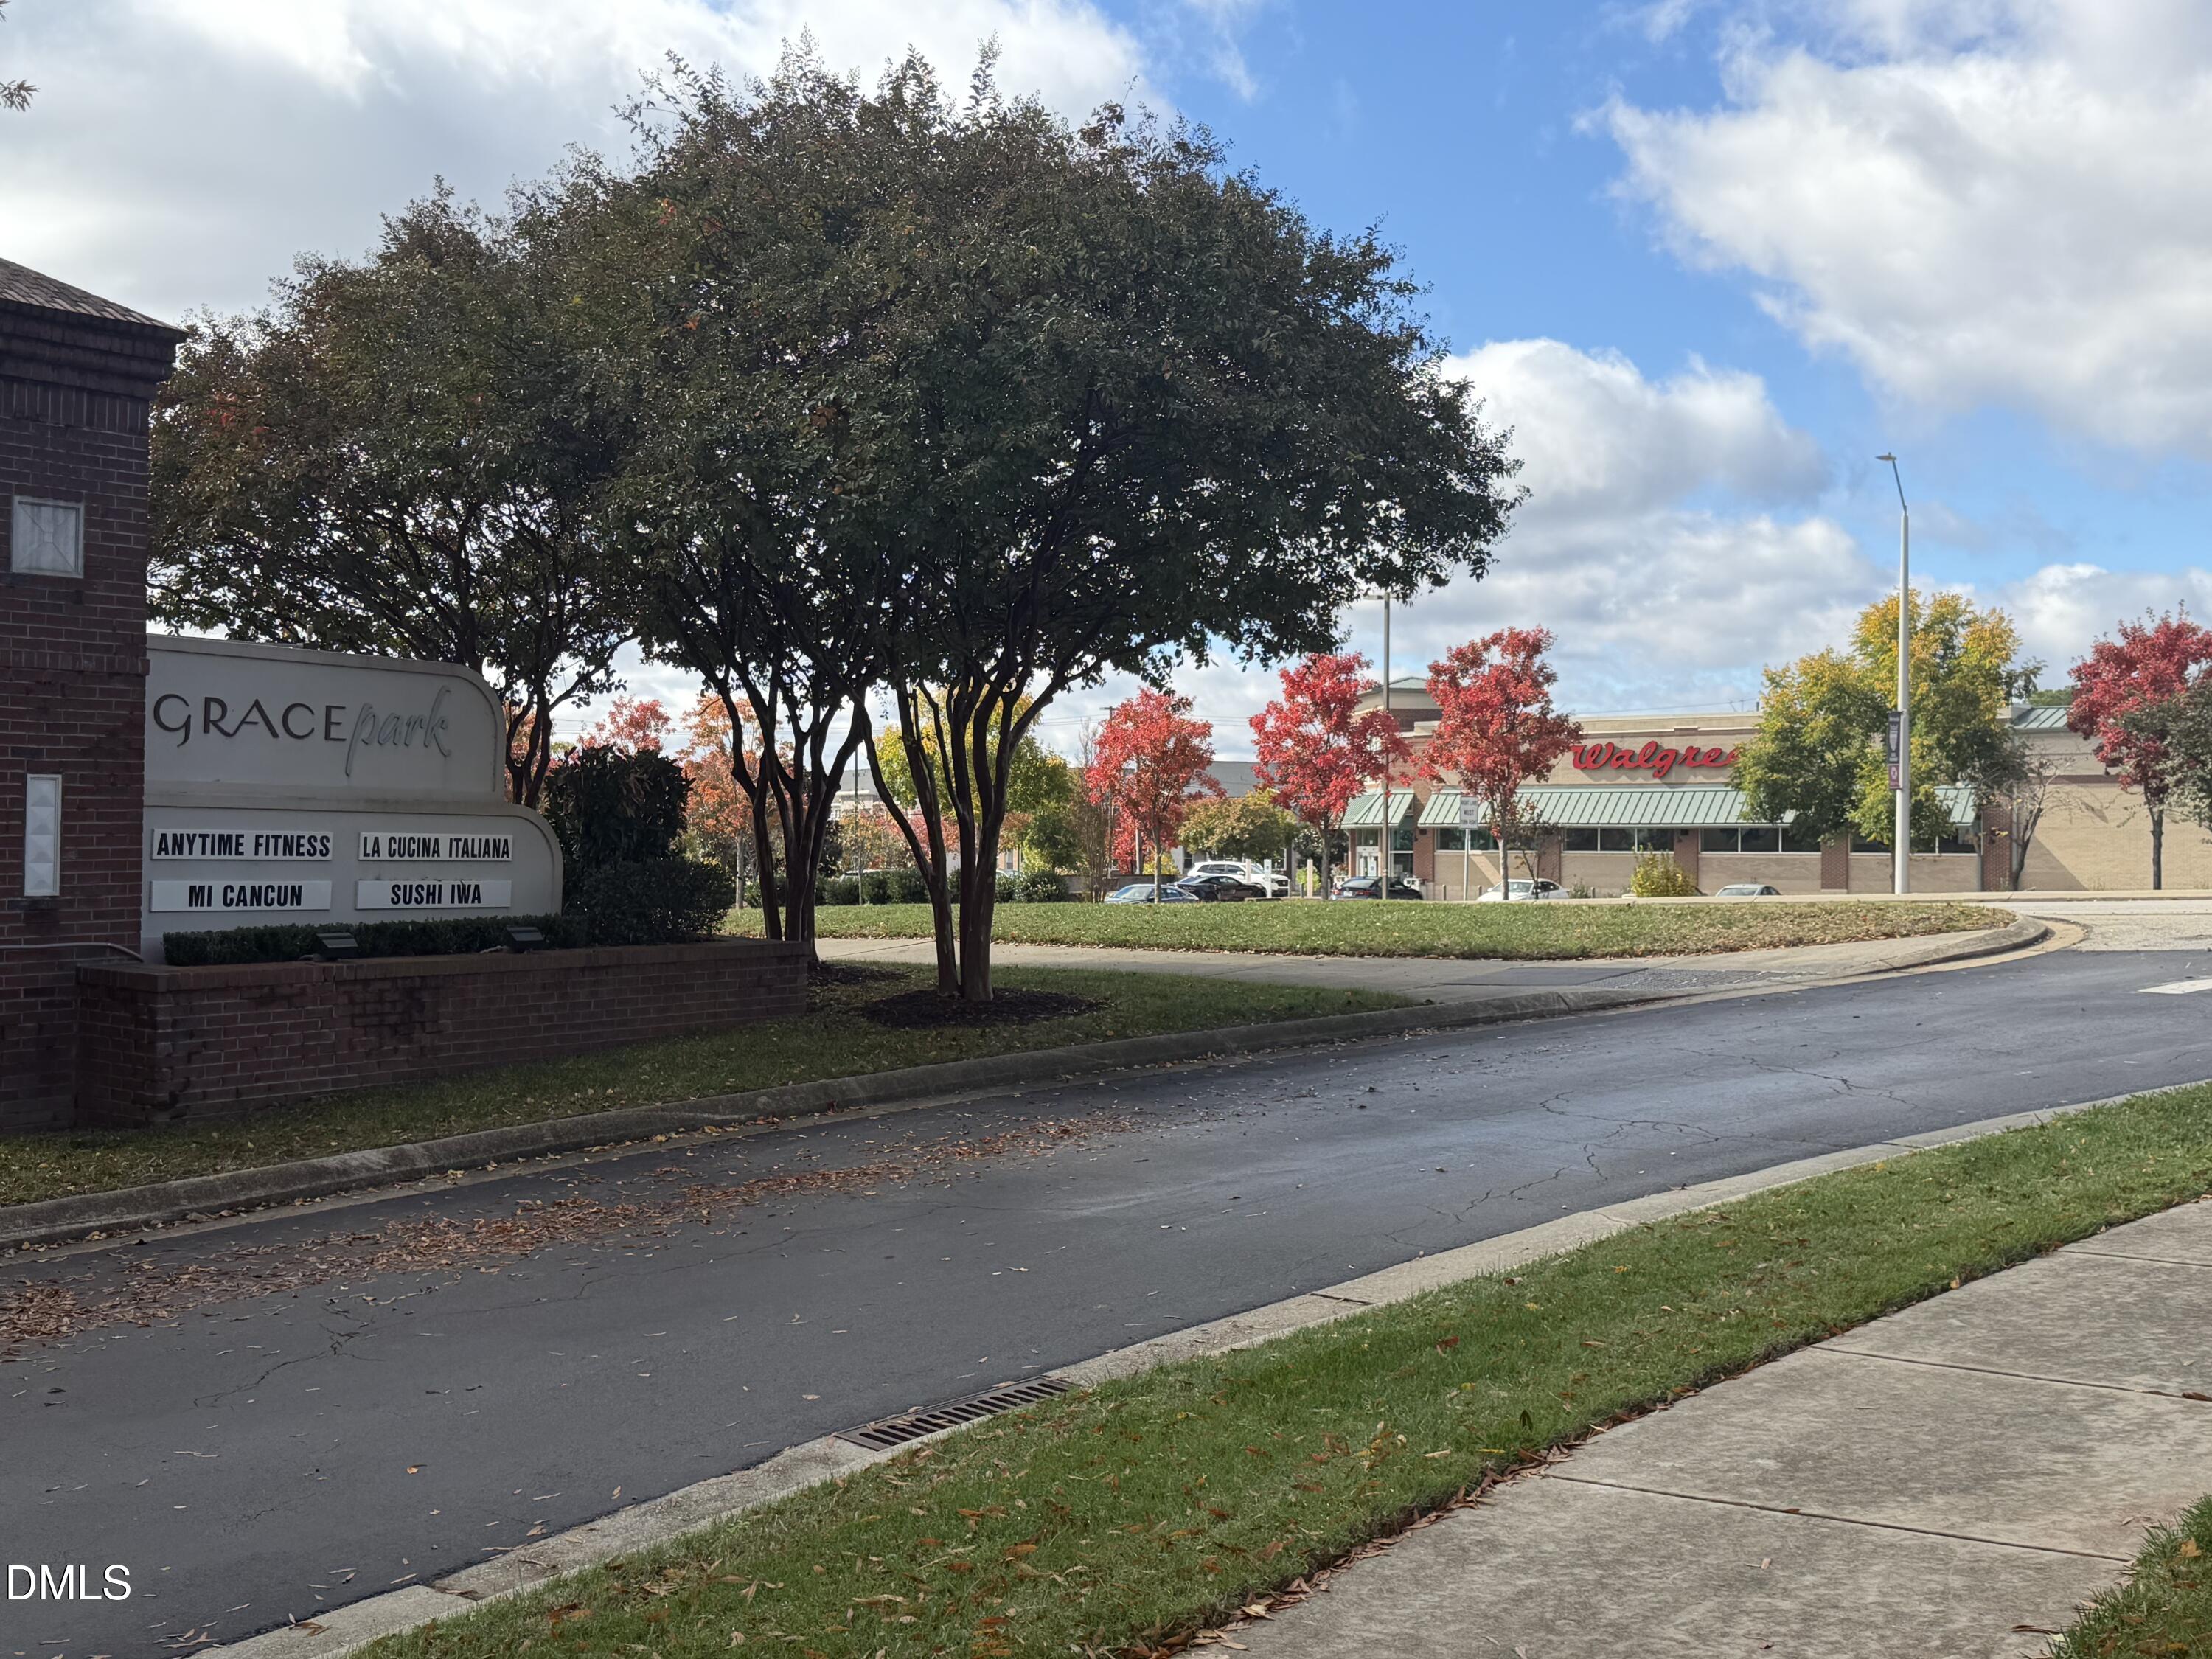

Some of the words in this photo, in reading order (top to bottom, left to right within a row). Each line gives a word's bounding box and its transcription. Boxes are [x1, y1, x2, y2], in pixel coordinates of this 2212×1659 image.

[153, 693, 347, 748] GRACE
[345, 685, 451, 777] park
[156, 832, 245, 856] ANYTIME
[254, 834, 330, 858] FITNESS
[363, 836, 380, 858] LA
[388, 836, 441, 858] CUCINA
[448, 837, 510, 858] ITALIANA
[188, 885, 213, 908] MI
[223, 884, 303, 908] CANCUN
[390, 884, 442, 905] SUSHI
[450, 883, 481, 905] IWA
